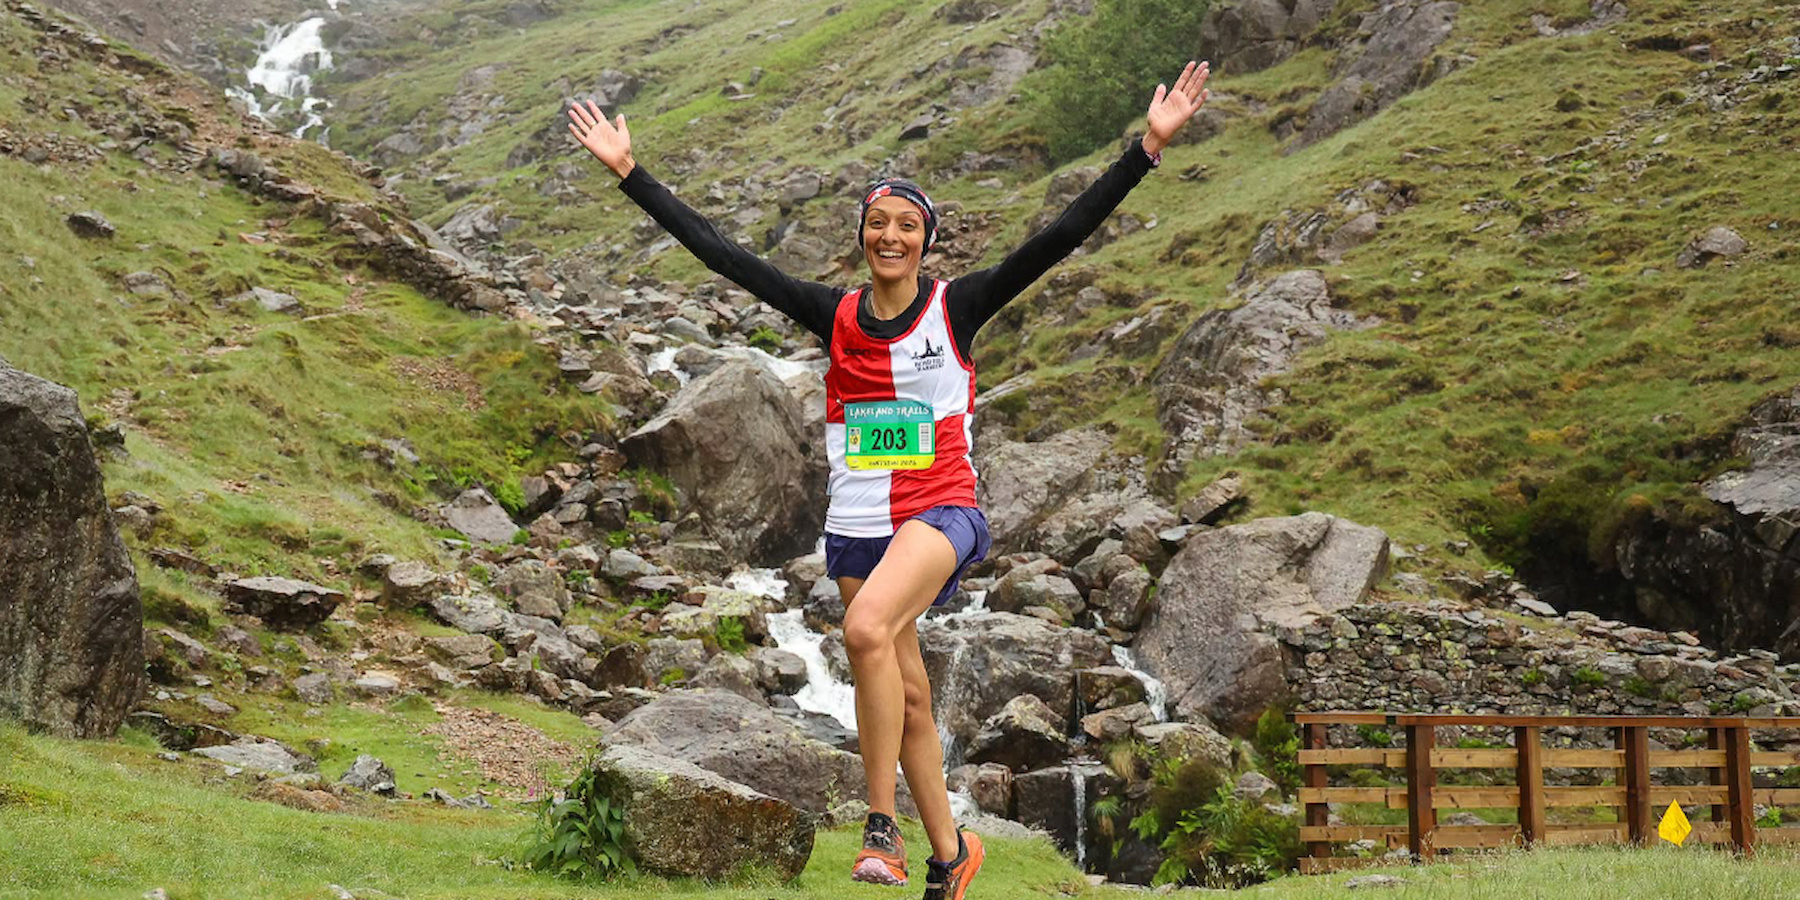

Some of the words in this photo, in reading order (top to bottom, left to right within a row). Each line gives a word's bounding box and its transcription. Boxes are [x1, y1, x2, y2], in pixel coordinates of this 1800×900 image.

[849, 406, 893, 419] LAKELAND
[896, 405, 930, 418] TRAILS
[872, 427, 907, 450] 203
